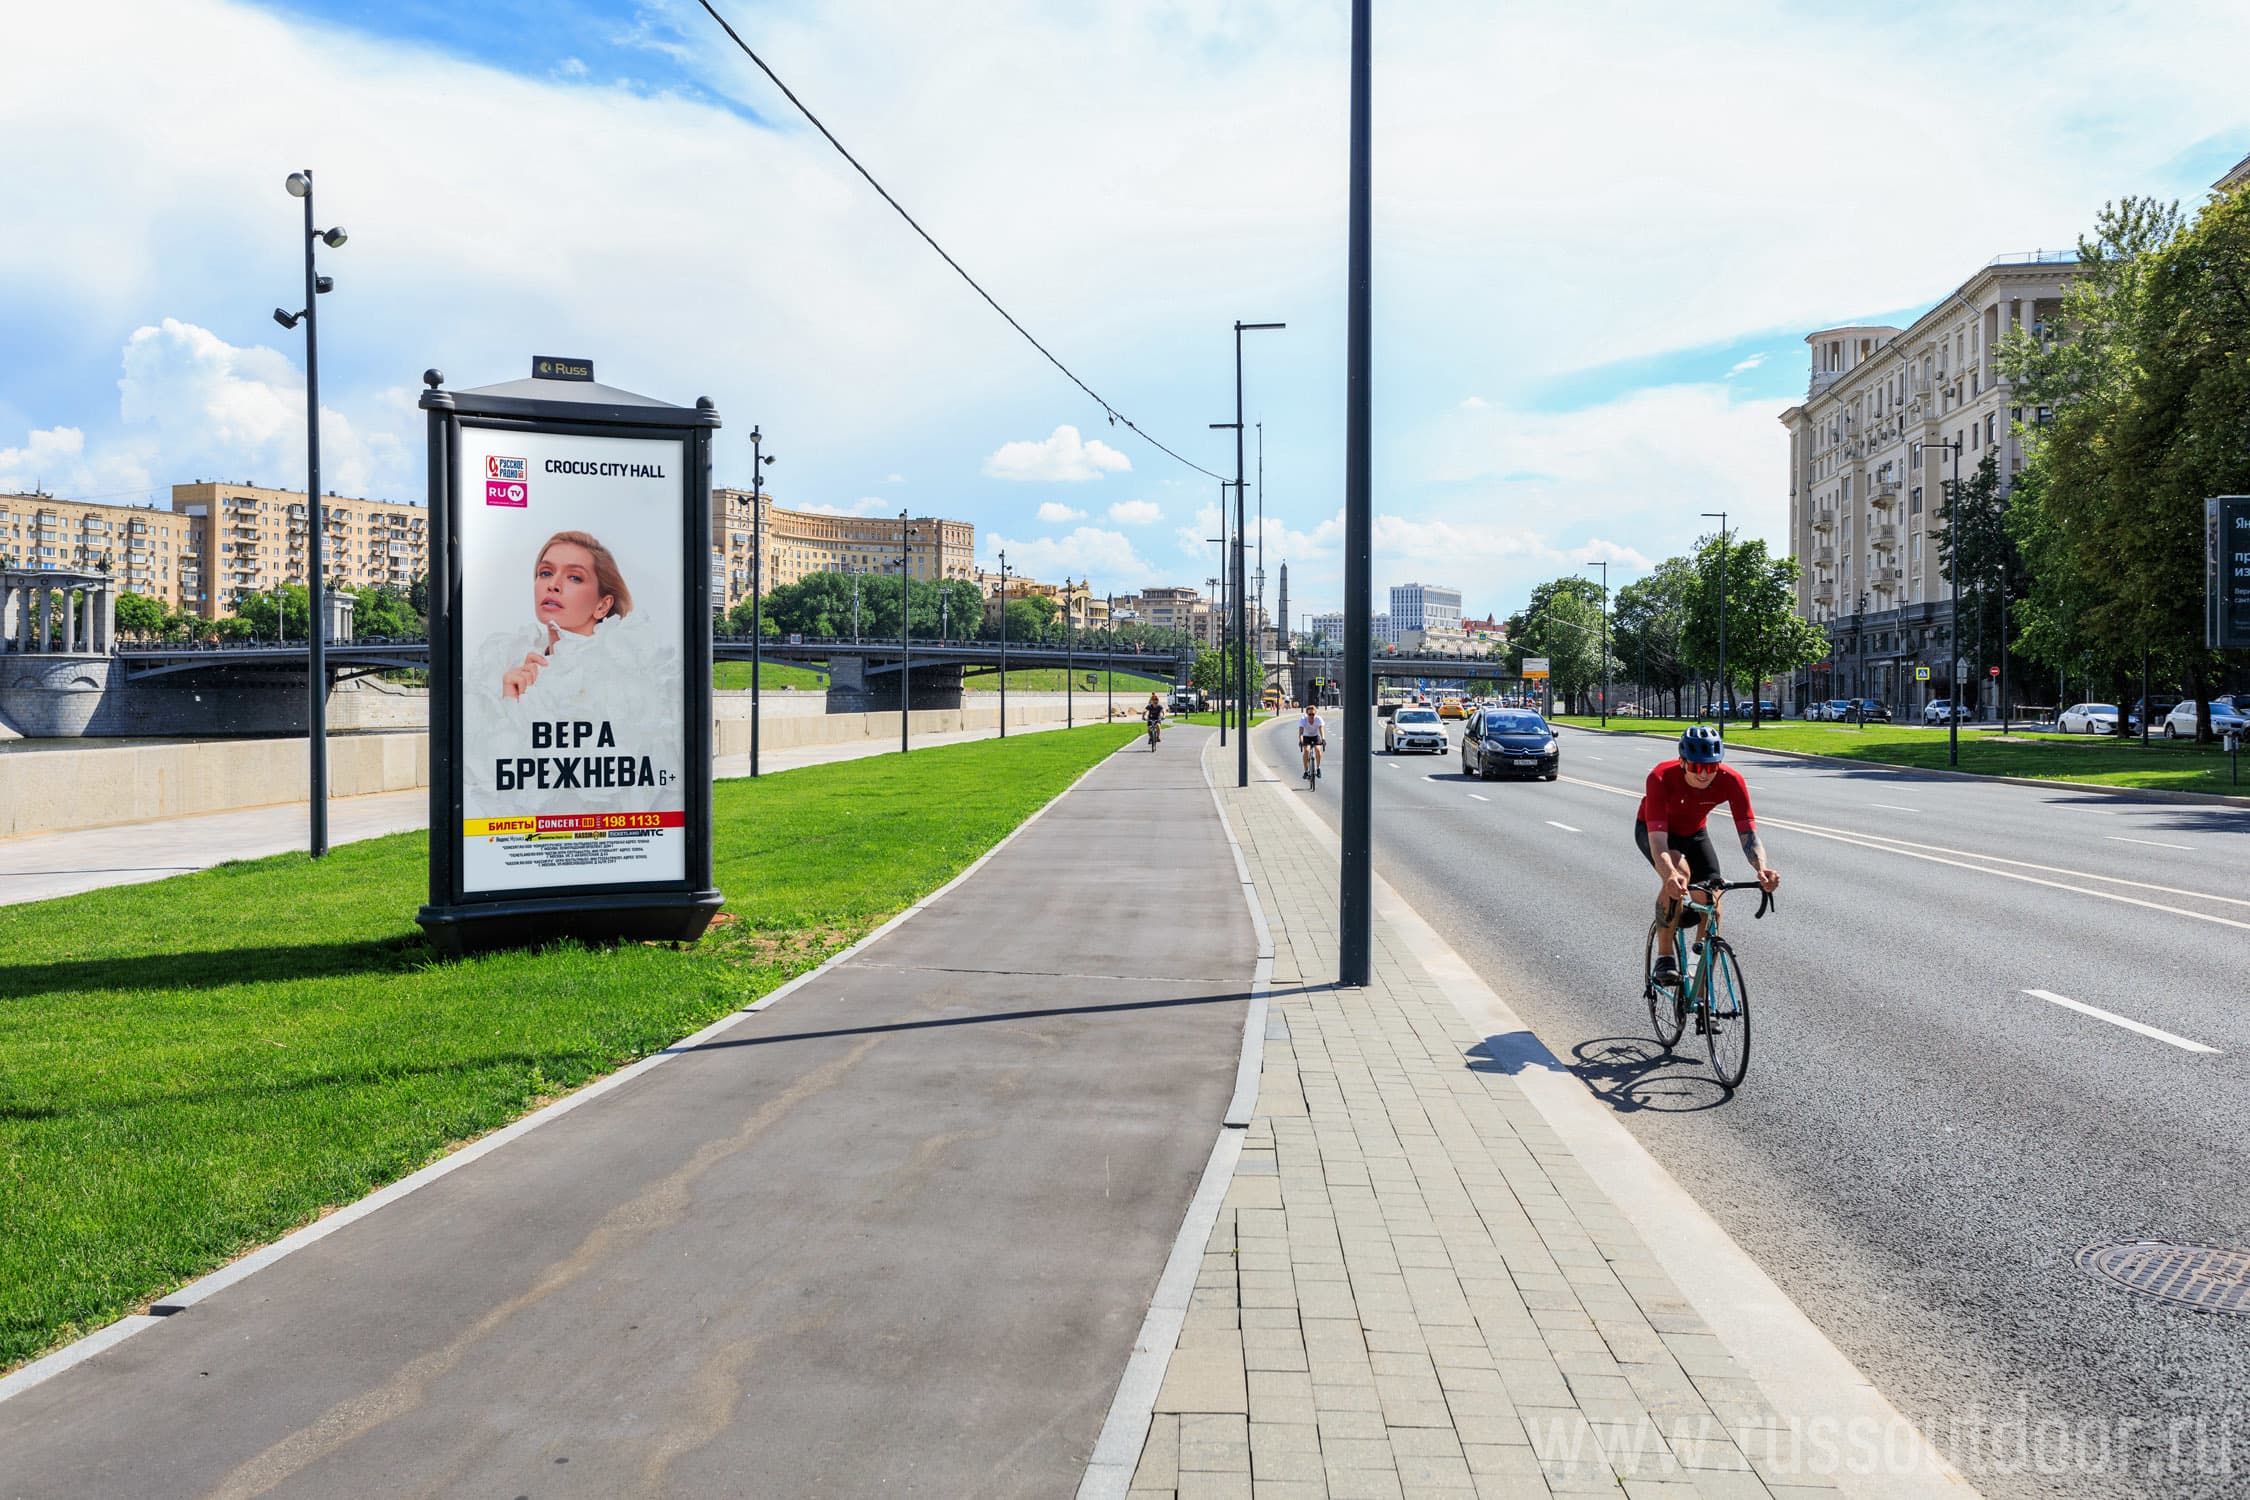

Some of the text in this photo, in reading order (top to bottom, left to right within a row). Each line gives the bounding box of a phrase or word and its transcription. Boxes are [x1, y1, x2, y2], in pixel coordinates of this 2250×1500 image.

[555, 363, 588, 376] Russ
[545, 459, 665, 478] CROCUS CITY HALL
[532, 721, 616, 749] ВЕРА
[496, 756, 676, 791] БРЕЖНЕВА 6+
[488, 820, 534, 831] БИЛЕТЫ
[603, 815, 626, 827] 198
[629, 814, 660, 826] 1133
